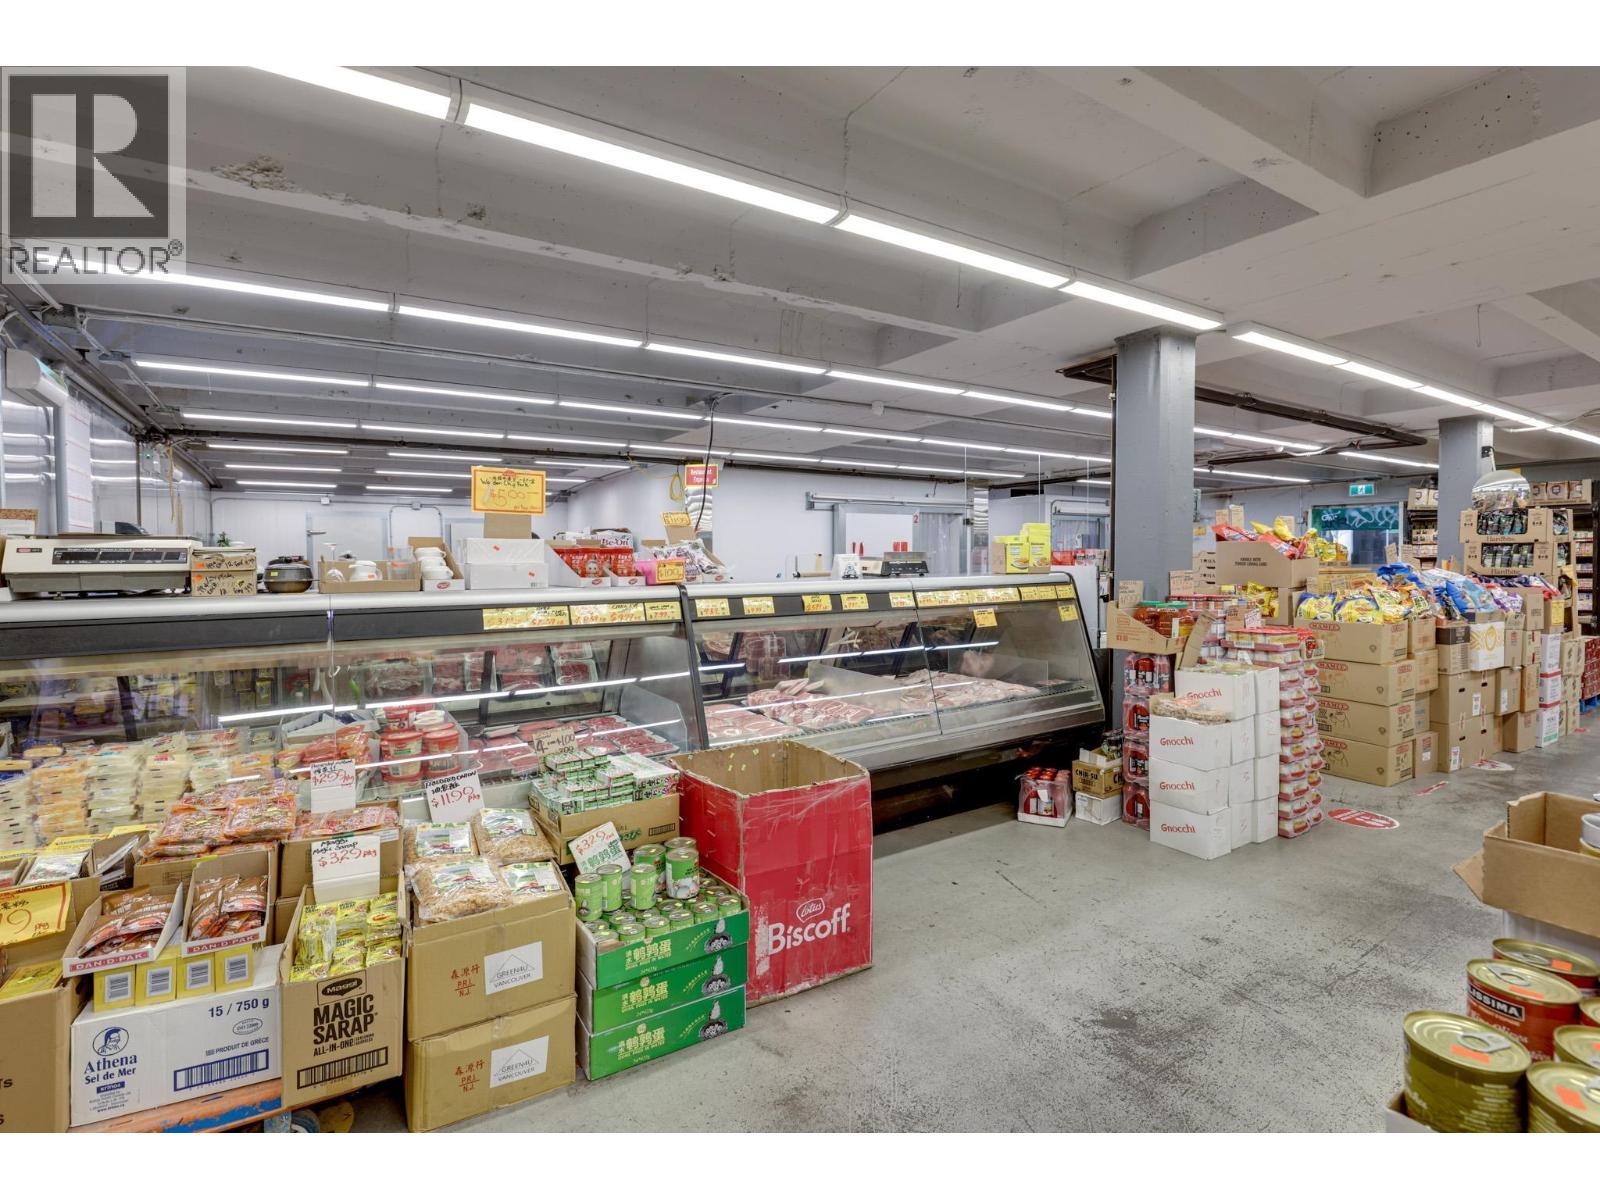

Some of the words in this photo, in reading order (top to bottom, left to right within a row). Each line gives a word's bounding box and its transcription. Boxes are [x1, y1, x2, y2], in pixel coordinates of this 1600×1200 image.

[1160, 736, 1194, 746] Gnocchi
[1159, 781, 1195, 790] Gnocchi
[1161, 824, 1196, 834] Gnocchi
[768, 902, 850, 956] Biscoff
[494, 973, 531, 988] VANCOUVER
[208, 1005, 223, 1018] 15
[226, 1003, 233, 1016] /
[236, 998, 259, 1013] 750
[262, 998, 270, 1009] g
[313, 994, 375, 1027] MAGIC
[215, 1044, 239, 1055] PRODUIT
[240, 1042, 249, 1050] DE
[313, 1038, 354, 1057] ALL-IN-ONE
[84, 1055, 138, 1075] Athena
[84, 1074, 100, 1085] Sel
[102, 1070, 115, 1081] de
[117, 1067, 137, 1078] Mer
